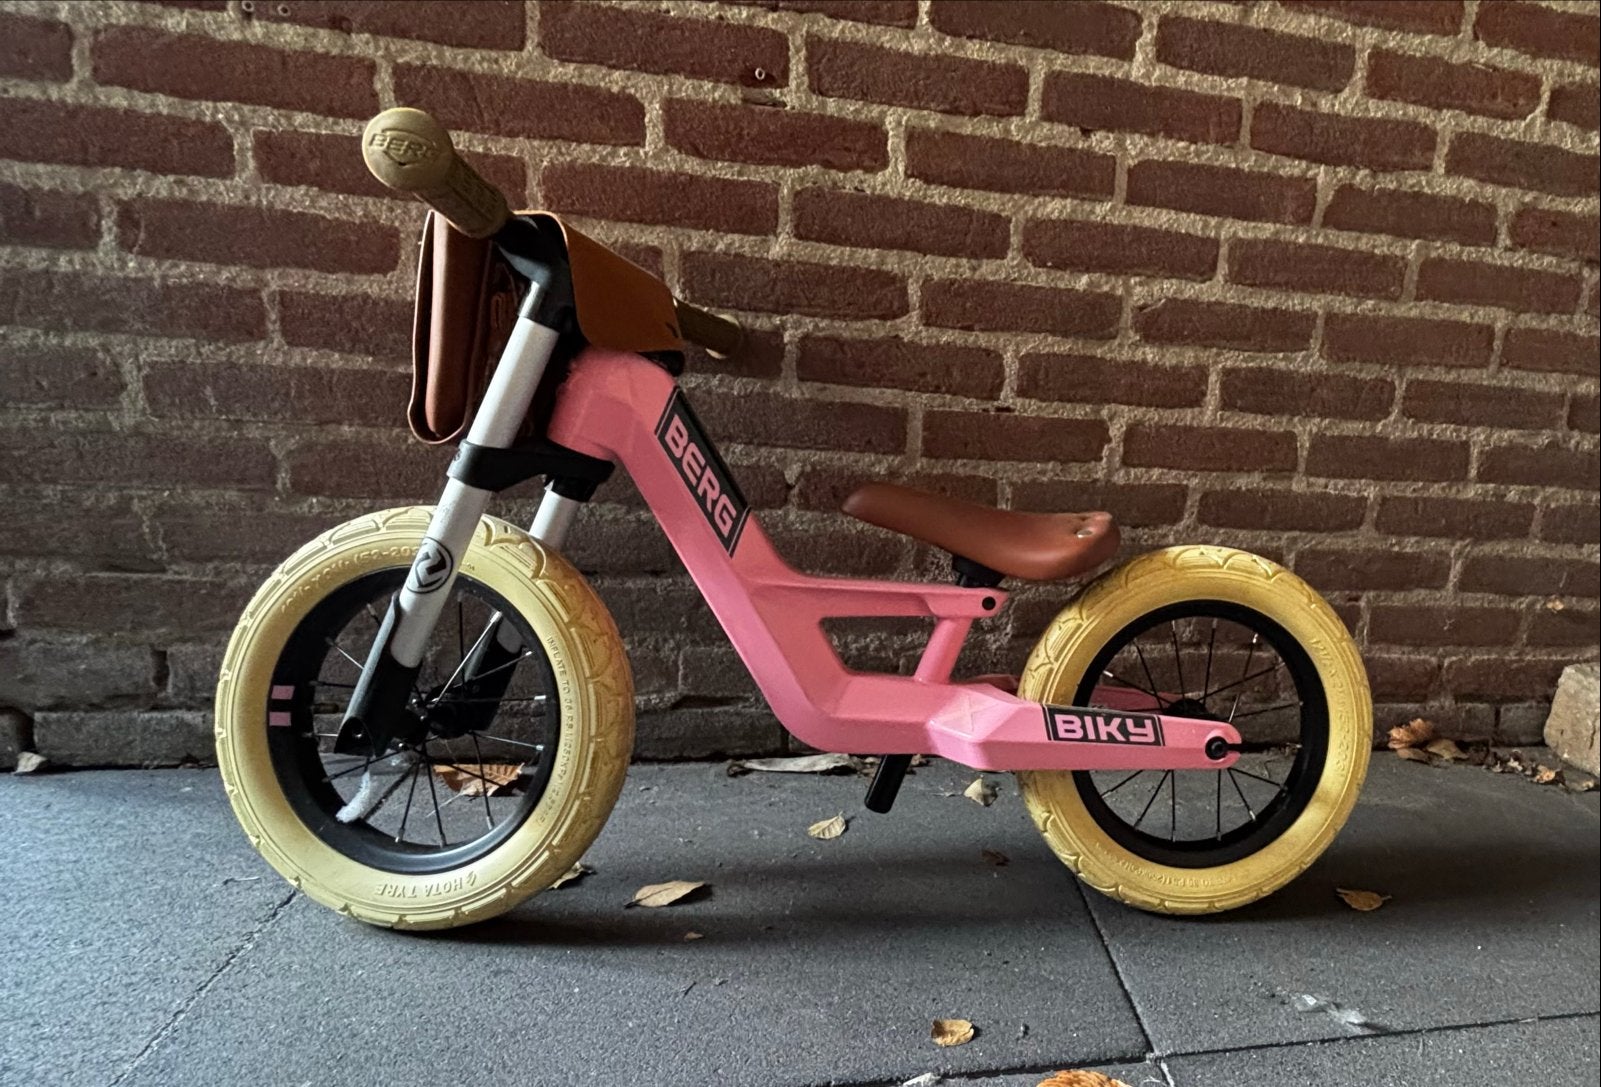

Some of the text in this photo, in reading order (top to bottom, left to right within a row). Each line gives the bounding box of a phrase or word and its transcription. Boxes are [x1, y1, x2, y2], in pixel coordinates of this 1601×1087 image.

[371, 132, 434, 158] BER
[664, 414, 737, 538] BERG
[546, 636, 567, 676] INFLATE
[1053, 713, 1156, 743] BIKY
[374, 877, 464, 899] HOTA TYRE
